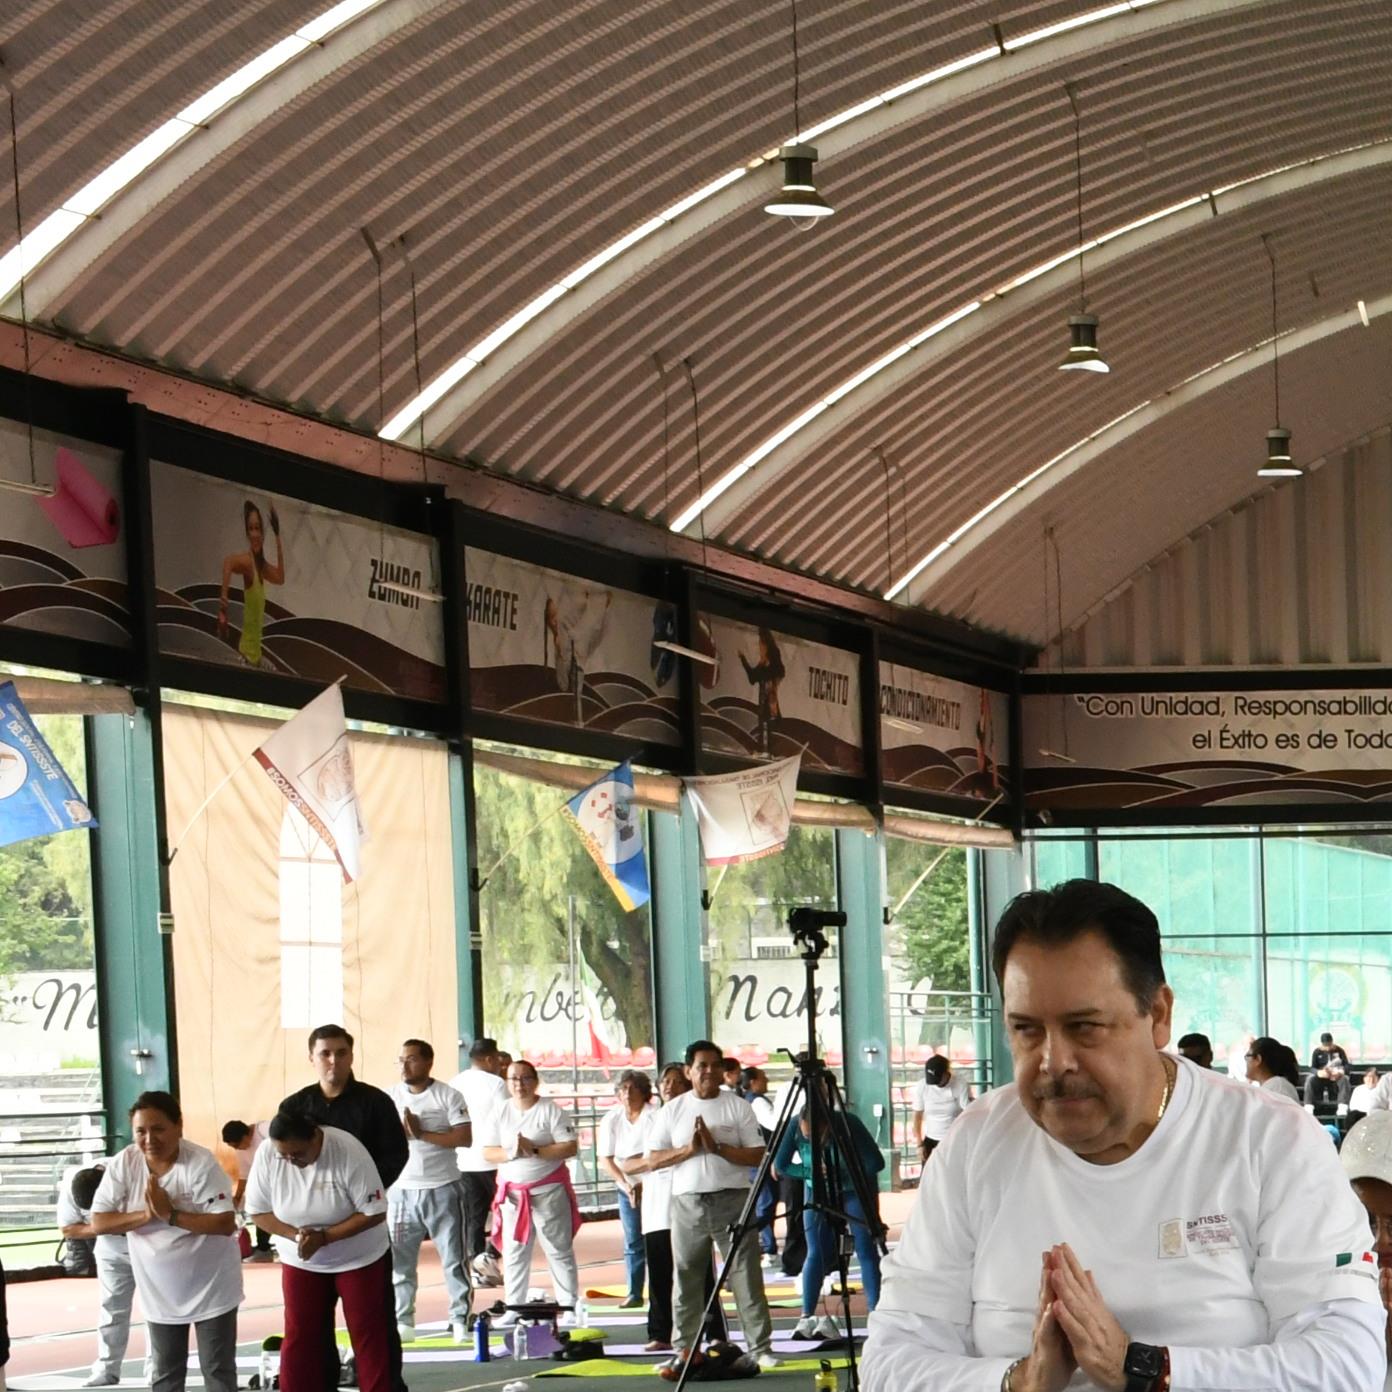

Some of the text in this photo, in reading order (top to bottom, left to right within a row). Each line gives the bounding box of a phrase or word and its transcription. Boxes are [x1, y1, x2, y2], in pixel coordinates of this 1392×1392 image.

[808, 667, 849, 706] TOCHITO
[1192, 730, 1212, 750] el
[1219, 724, 1269, 750] Éxito
[1275, 733, 1300, 750] es
[1307, 730, 1338, 750] de
